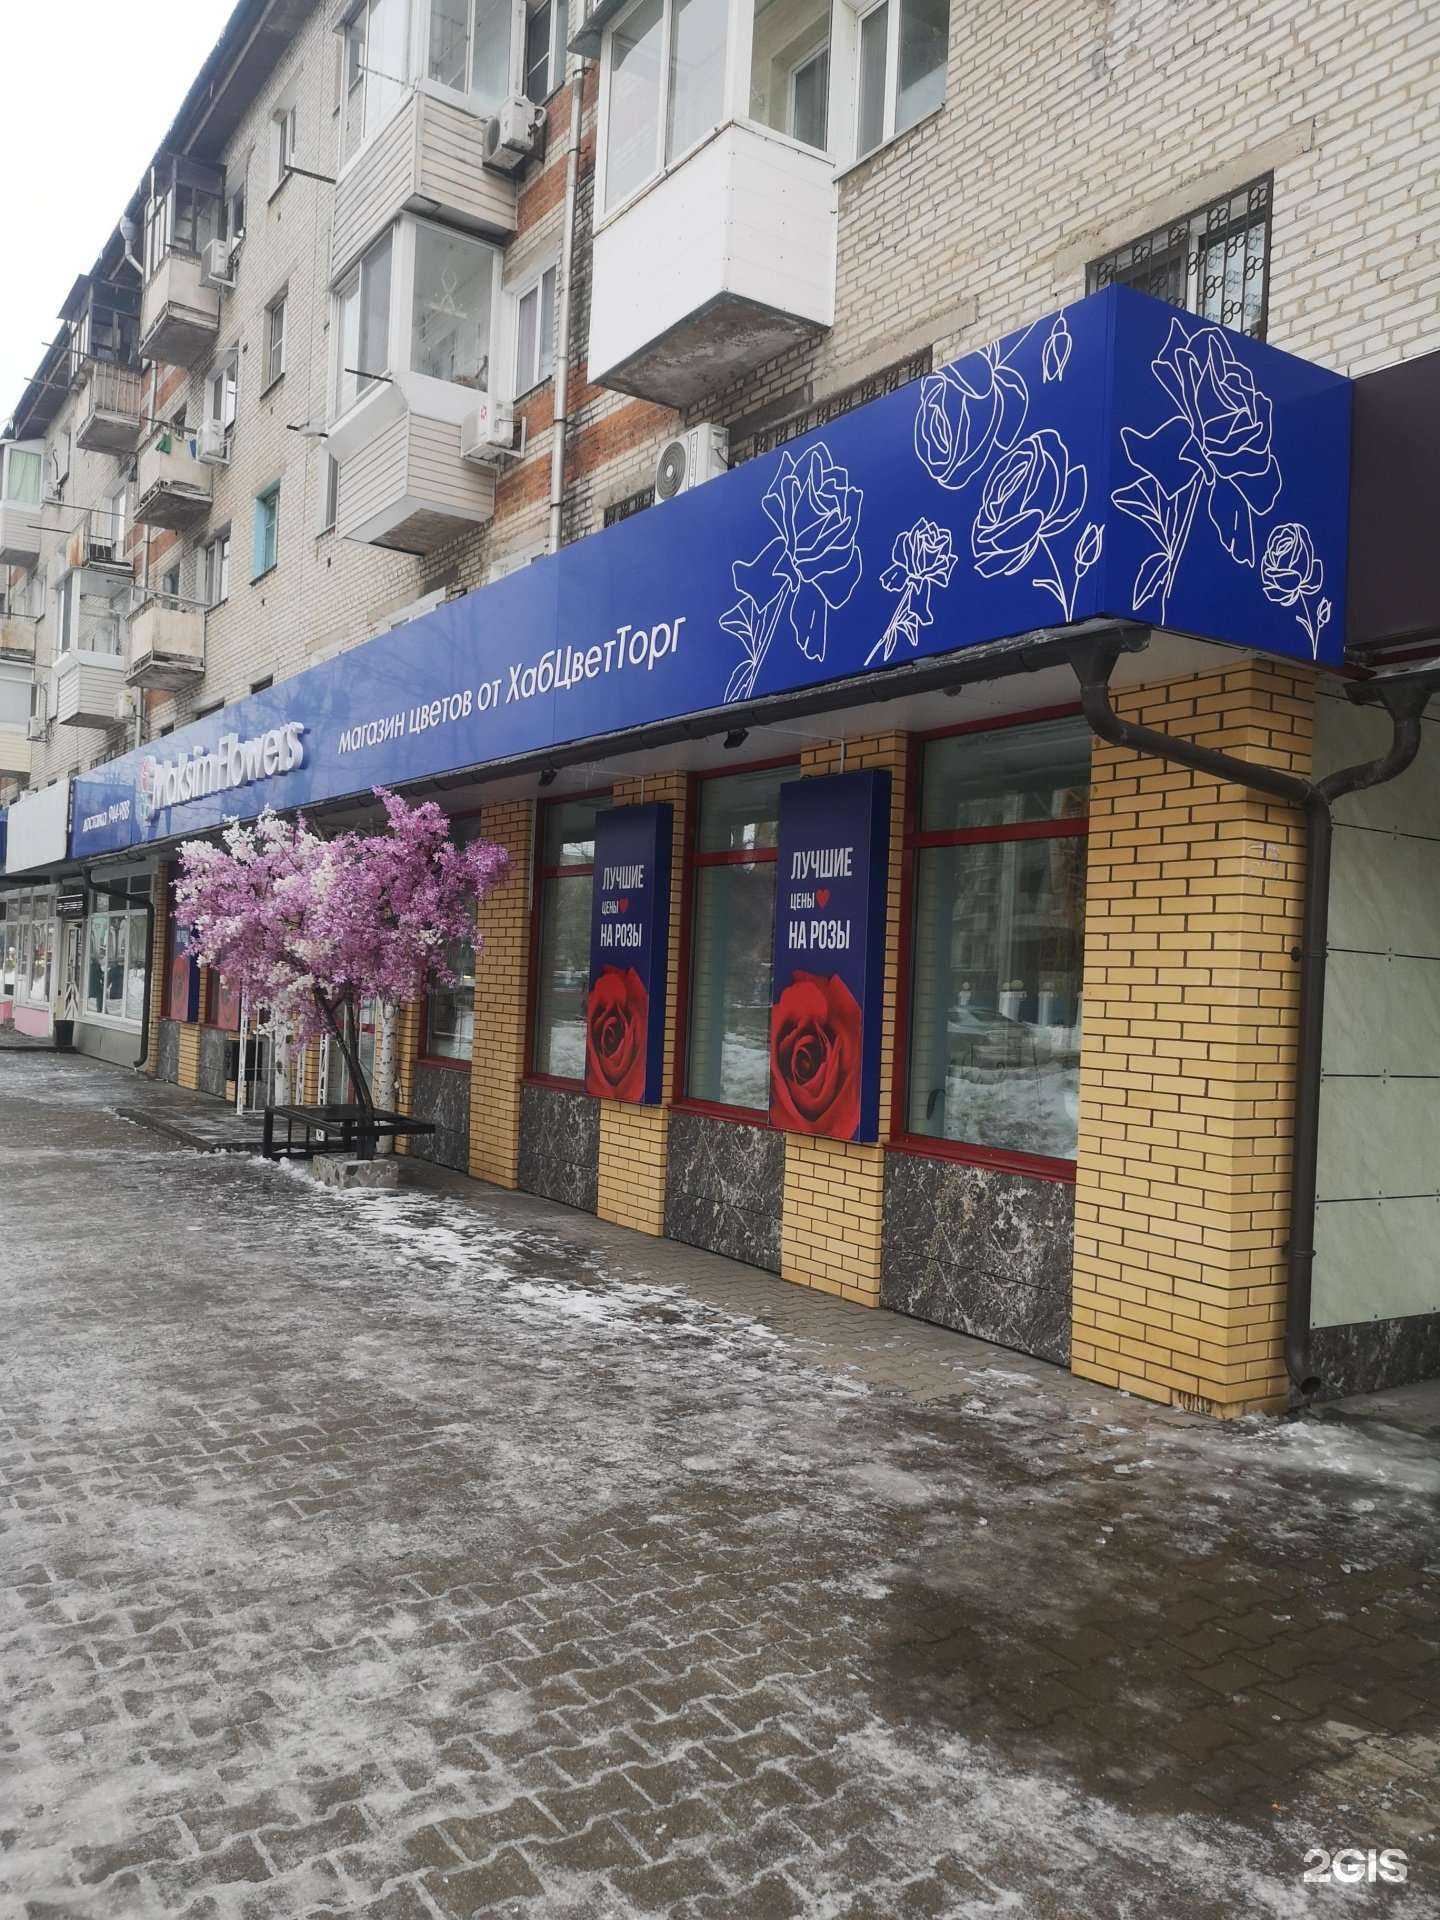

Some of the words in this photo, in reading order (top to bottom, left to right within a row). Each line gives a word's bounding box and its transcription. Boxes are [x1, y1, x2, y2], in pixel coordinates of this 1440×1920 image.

[338, 711, 405, 754] магазин
[409, 689, 472, 734] цветов
[477, 679, 502, 711] от
[506, 617, 686, 703] ХабЦветТорг
[790, 847, 854, 880] ЛУЧШИЕ
[602, 864, 645, 890] ЛУЧШИЕ
[601, 900, 619, 916] ЦЕНЫ
[790, 892, 815, 911] ЦЕНЫ
[600, 923, 613, 947] НА
[615, 922, 643, 947] РОЗЫ
[788, 920, 807, 949] НА
[809, 919, 851, 949] РОЗЫ
